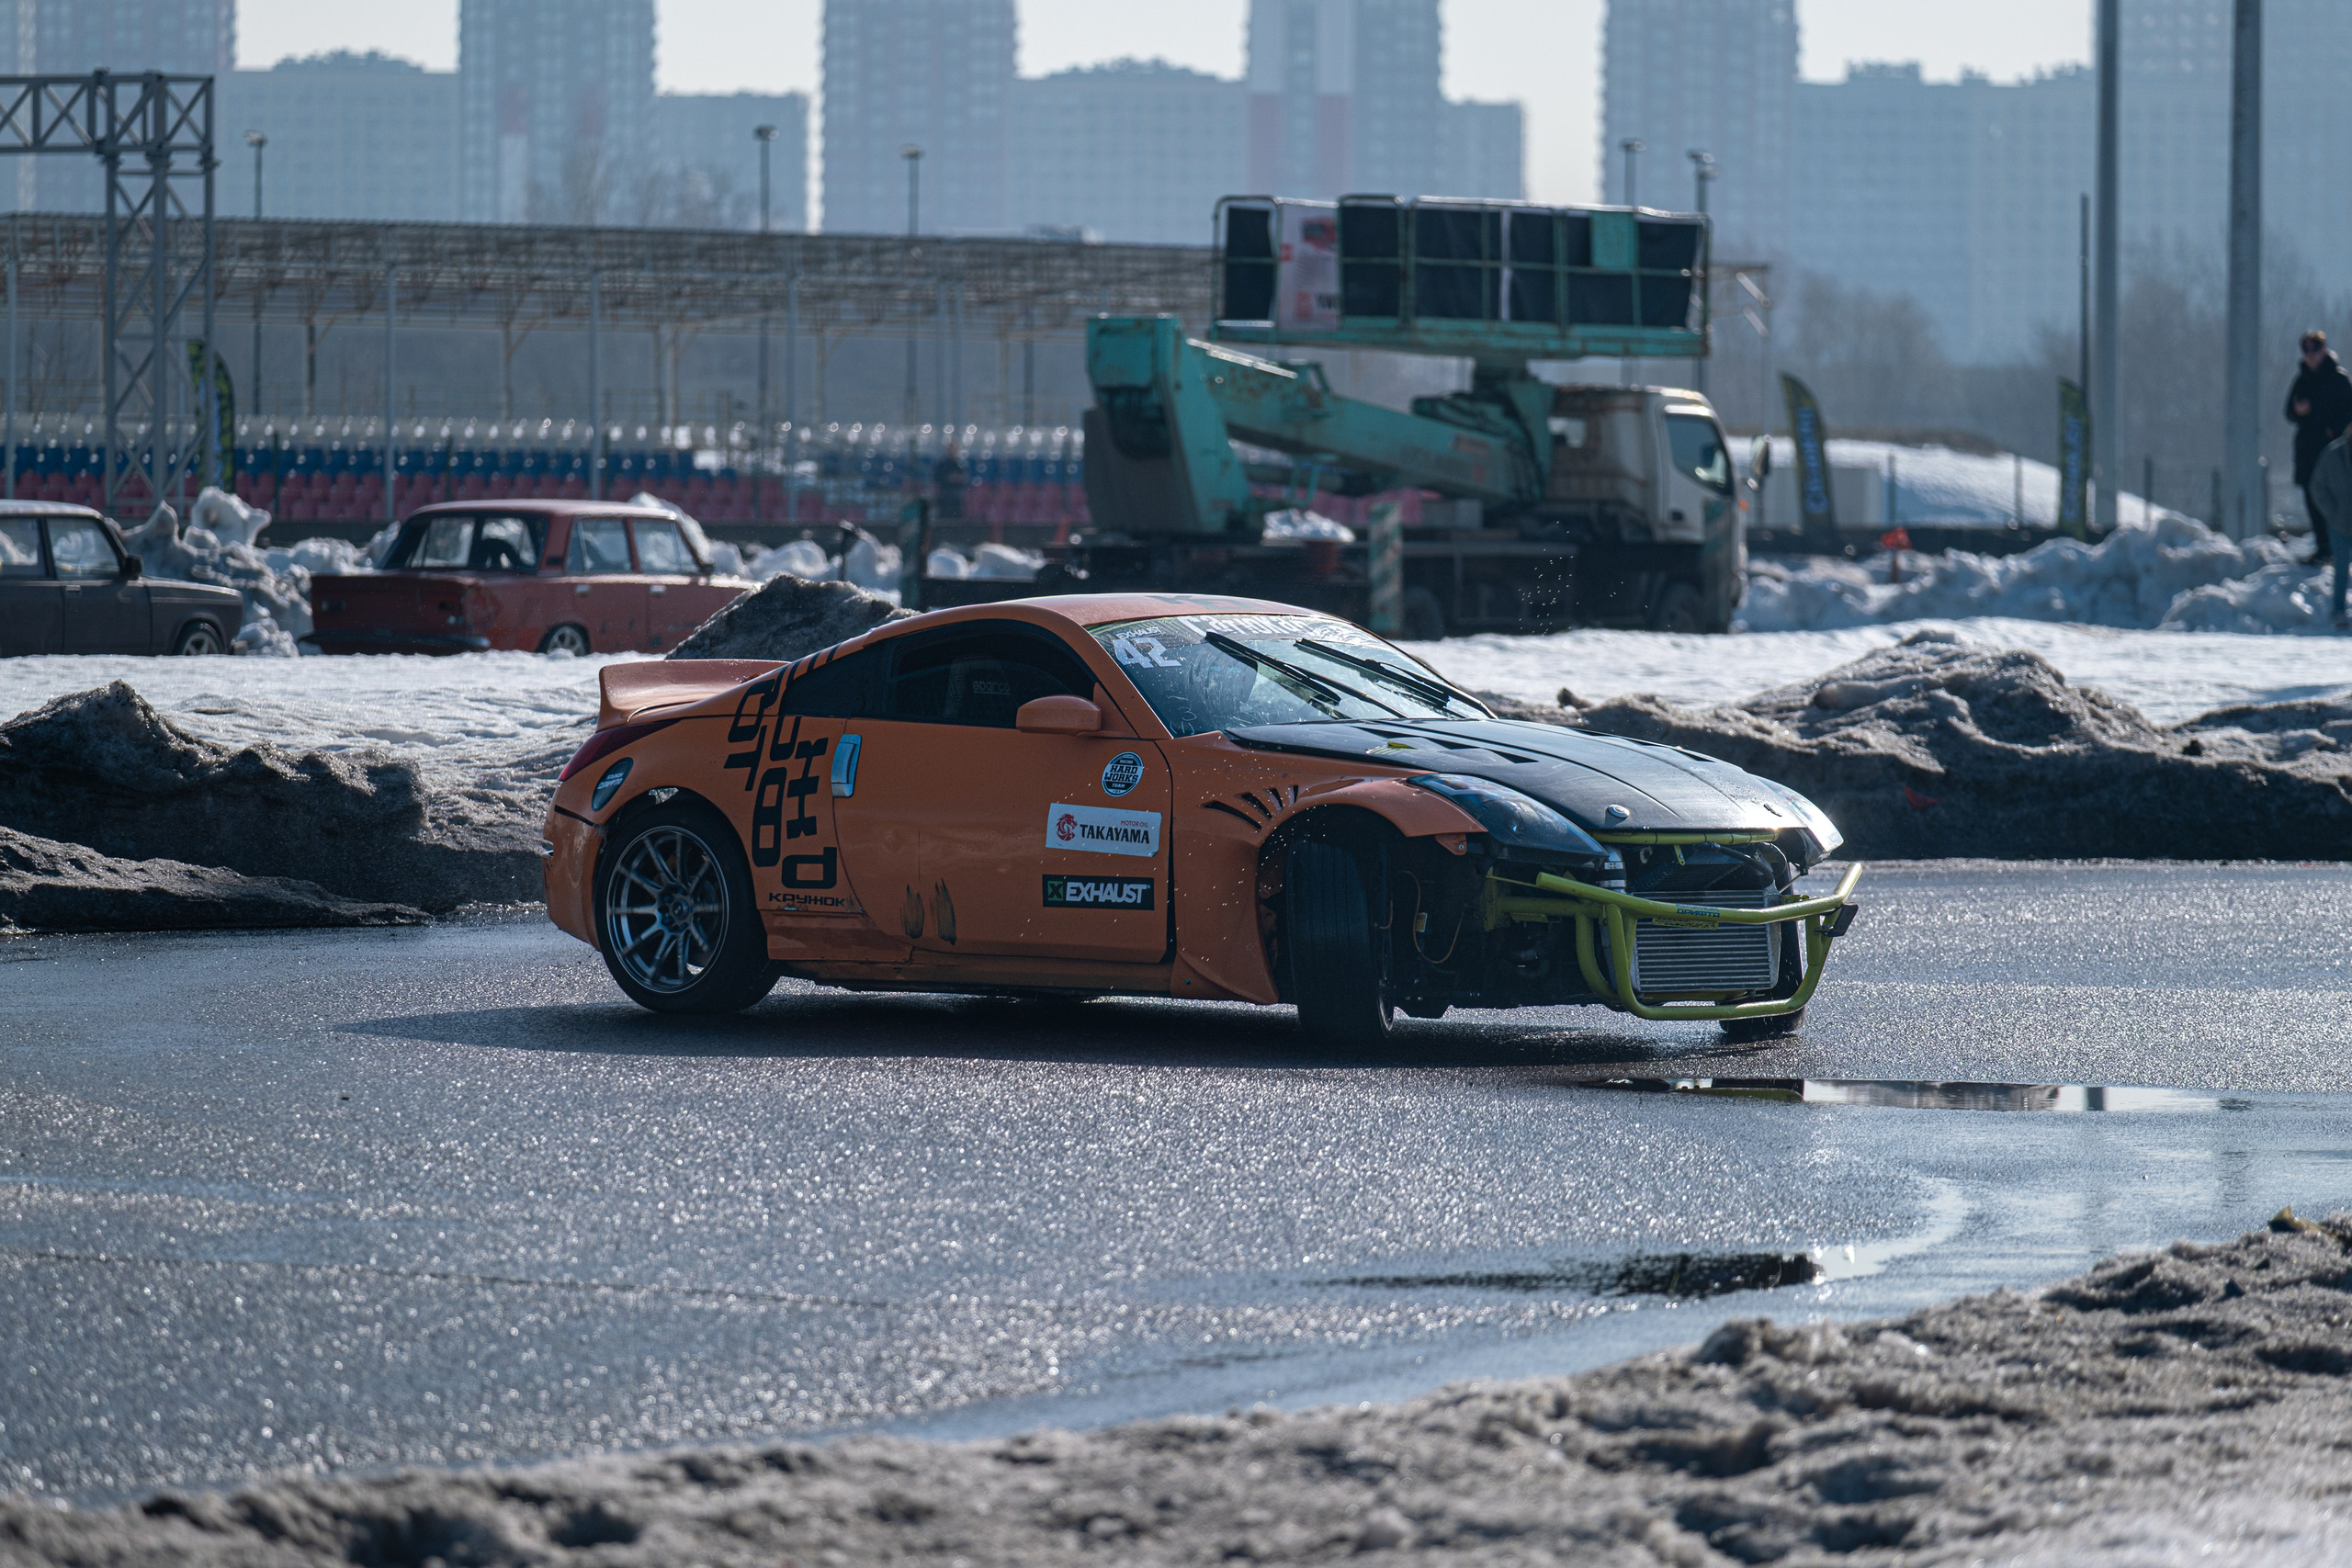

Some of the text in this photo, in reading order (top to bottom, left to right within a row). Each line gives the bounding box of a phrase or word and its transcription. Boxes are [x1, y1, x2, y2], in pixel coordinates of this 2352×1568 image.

[1115, 626, 1162, 639] EXHAUST
[1112, 637, 1182, 669] 42
[1110, 764, 1138, 774] HARD
[1103, 772, 1139, 783] WORKS
[1120, 819, 1139, 828] MOTOR
[1080, 823, 1150, 844] TAKAYAMA
[1066, 881, 1148, 904] EXHAUST
[768, 892, 846, 908] КРУЖОК
